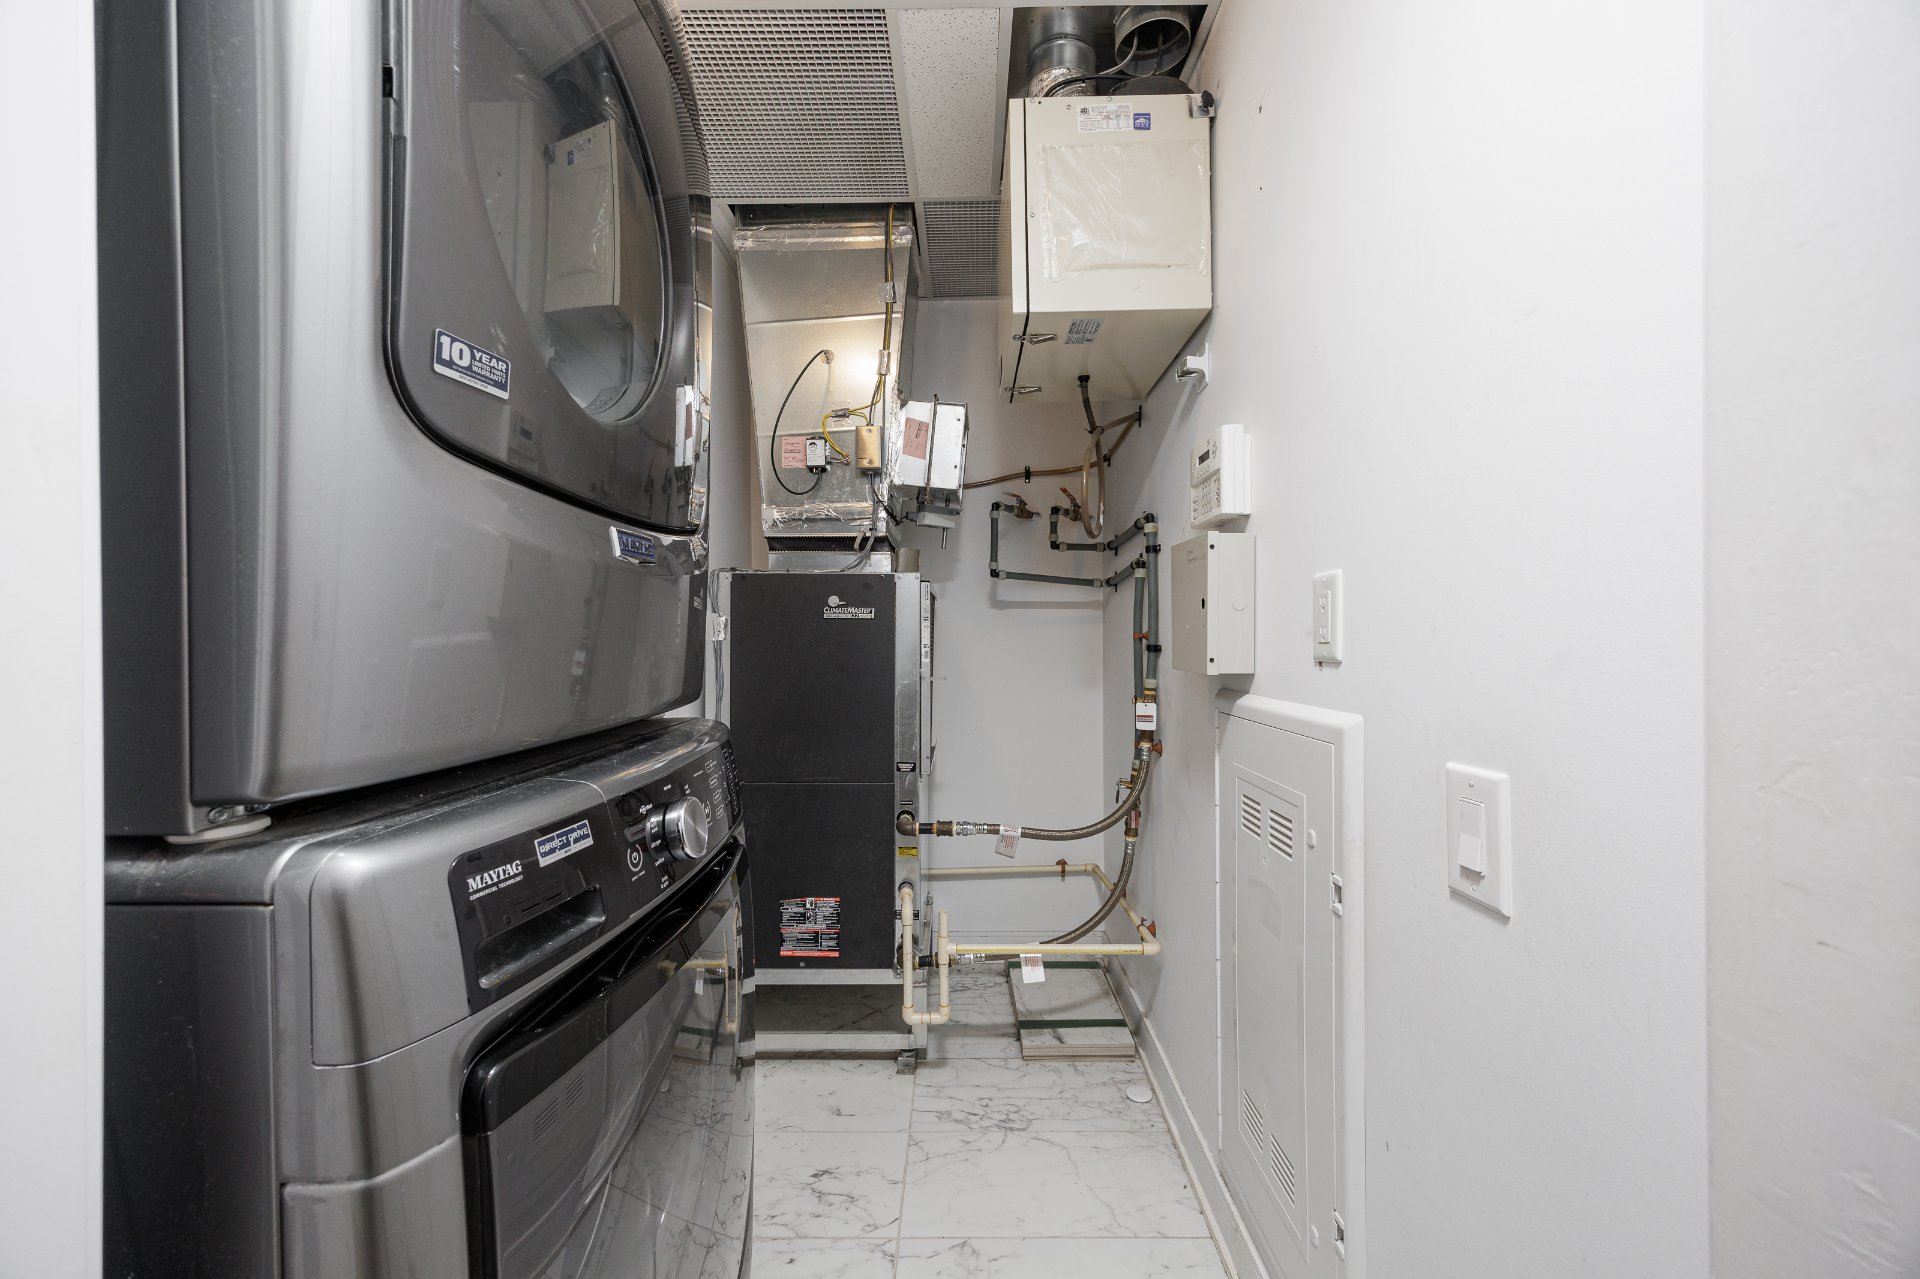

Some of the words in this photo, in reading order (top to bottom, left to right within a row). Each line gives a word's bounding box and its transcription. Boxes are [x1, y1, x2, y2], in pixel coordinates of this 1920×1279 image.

[440, 335, 471, 367] 10
[473, 349, 507, 372] YEAR
[472, 360, 491, 372] LIMITED
[492, 368, 506, 379] PARTS
[472, 365, 506, 384] WARRANTY
[539, 836, 567, 853] DIRECT
[568, 827, 589, 842] DRIVE
[467, 860, 522, 892] MAYTAG
[469, 886, 498, 901] COMMERCIAL
[498, 875, 523, 889] TECHNOLOGY
